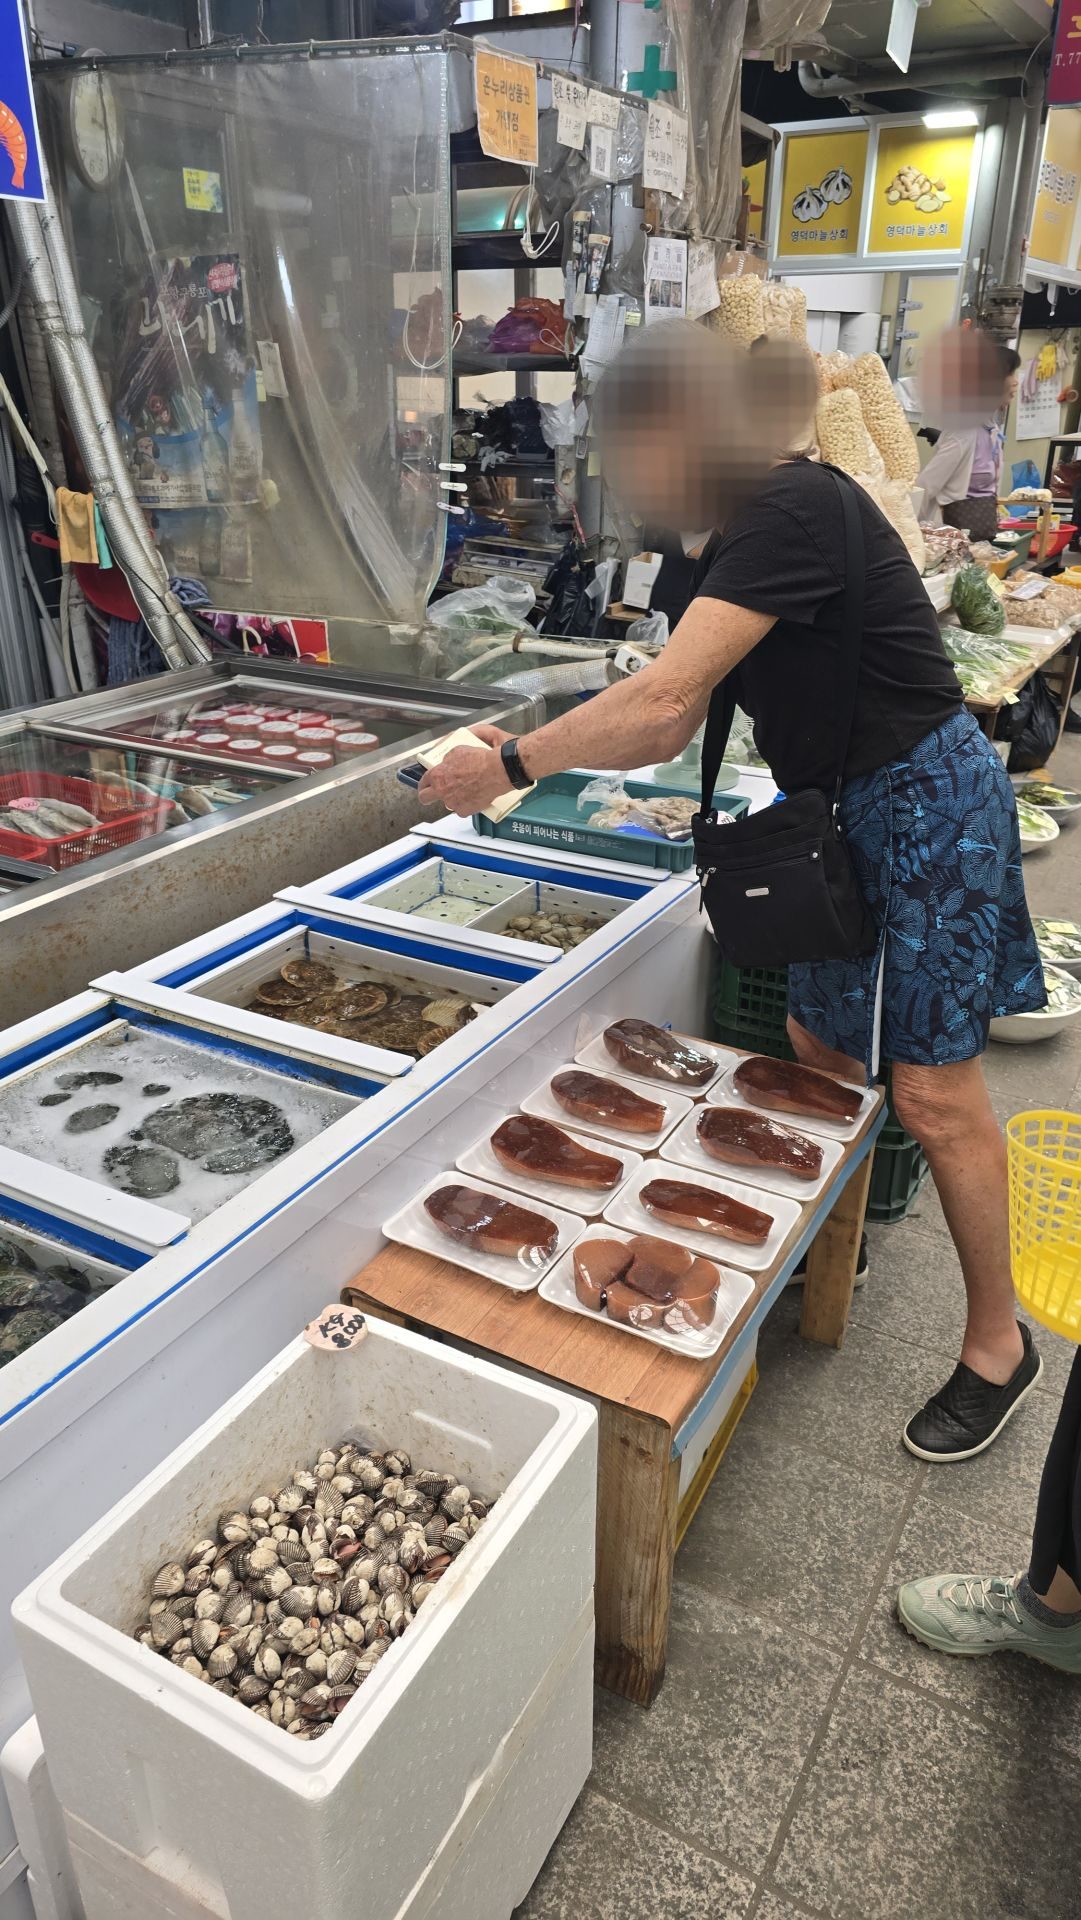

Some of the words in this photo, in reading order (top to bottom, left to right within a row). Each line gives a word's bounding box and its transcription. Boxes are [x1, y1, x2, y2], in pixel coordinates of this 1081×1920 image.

[483, 75, 530, 105] 온누리상품권
[790, 229, 849, 242] 영덕마늘상회
[885, 223, 948, 238] 영덕마늘상회
[533, 826, 559, 840] 피어나는
